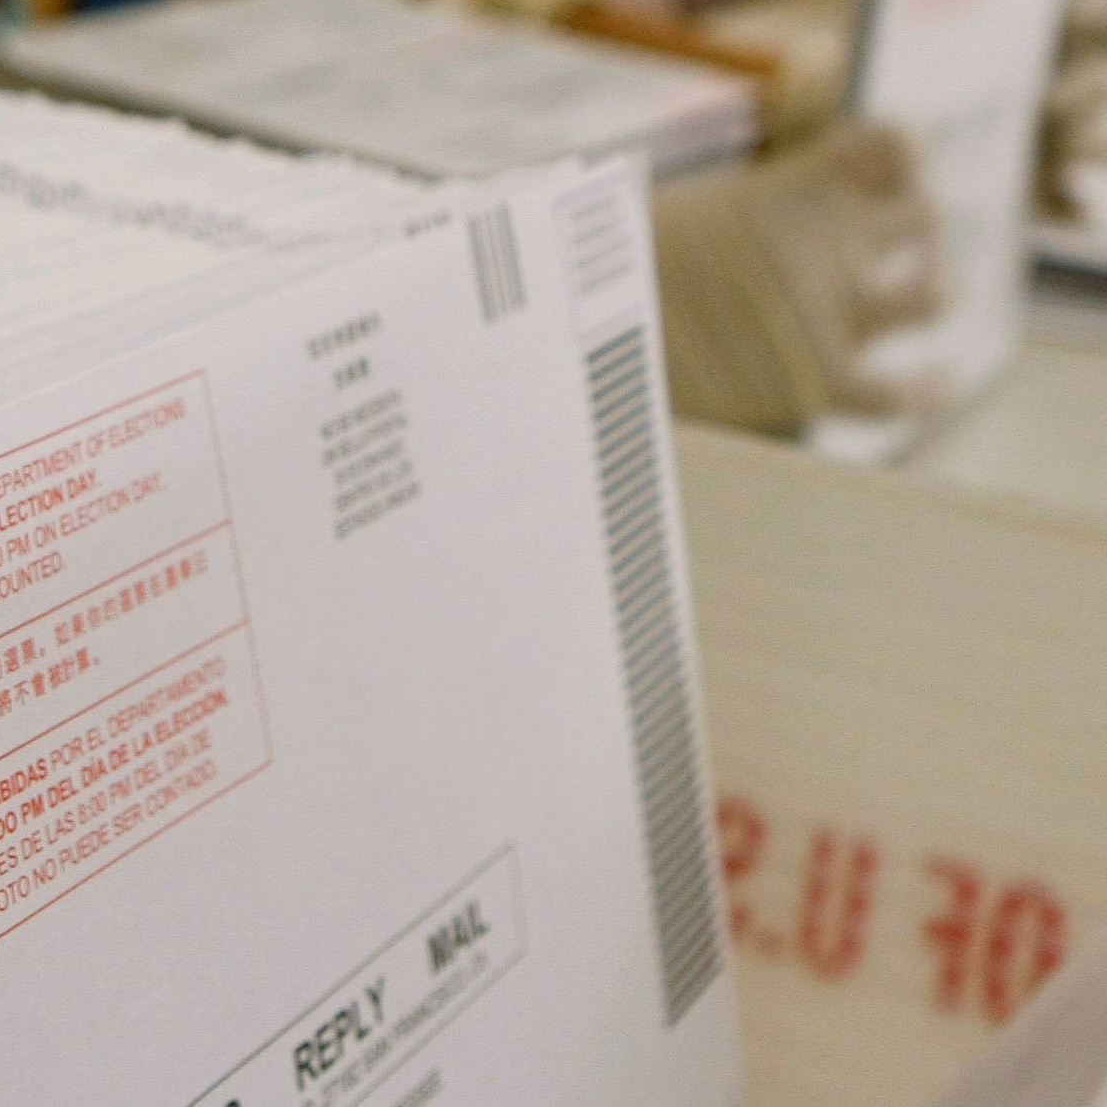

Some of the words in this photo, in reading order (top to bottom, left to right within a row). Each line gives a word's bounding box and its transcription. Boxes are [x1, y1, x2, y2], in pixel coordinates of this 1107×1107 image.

[5, 533, 32, 557] PM
[34, 523, 59, 548] ON
[50, 736, 85, 768] POR
[86, 727, 109, 753] EL
[20, 793, 46, 822] PM
[47, 778, 80, 810] DEL
[108, 743, 132, 772] DE
[134, 732, 155, 758] LA
[20, 831, 43, 862] DE
[47, 809, 76, 846] LAS
[32, 856, 59, 886] NO
[58, 823, 112, 869] PUEDE
[293, 975, 385, 1092] REPLY
